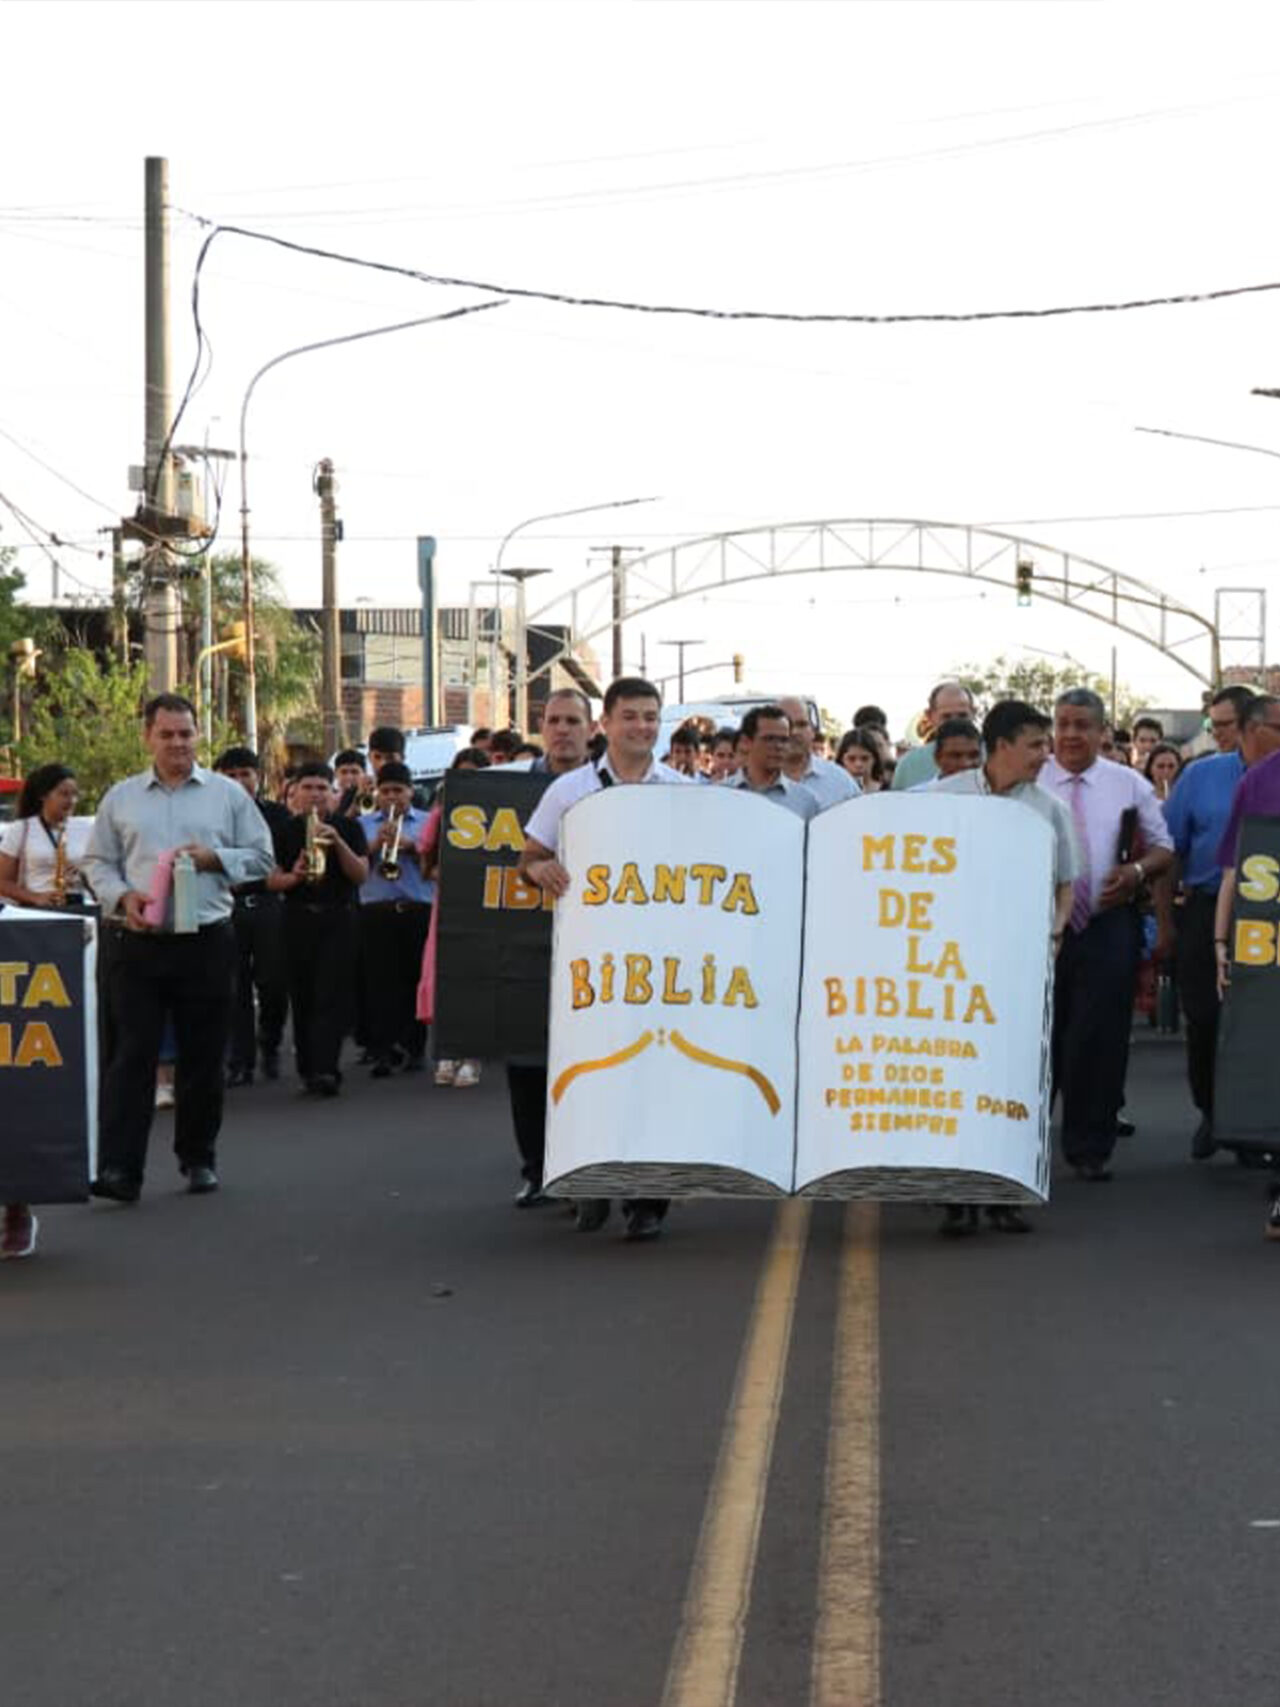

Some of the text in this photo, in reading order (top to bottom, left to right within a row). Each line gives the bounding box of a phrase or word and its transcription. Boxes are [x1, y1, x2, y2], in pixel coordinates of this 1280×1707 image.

[862, 834, 957, 873] MES
[582, 863, 759, 915] SANTA
[878, 889, 934, 930] DE
[907, 936, 967, 981] LA
[824, 976, 997, 1025] BIBLIA
[835, 1034, 978, 1059] LA PALABRA
[842, 1063, 944, 1084] DE DIOS
[826, 1088, 963, 1109] PERMANECE
[850, 1111, 957, 1136] SIEMPRE
